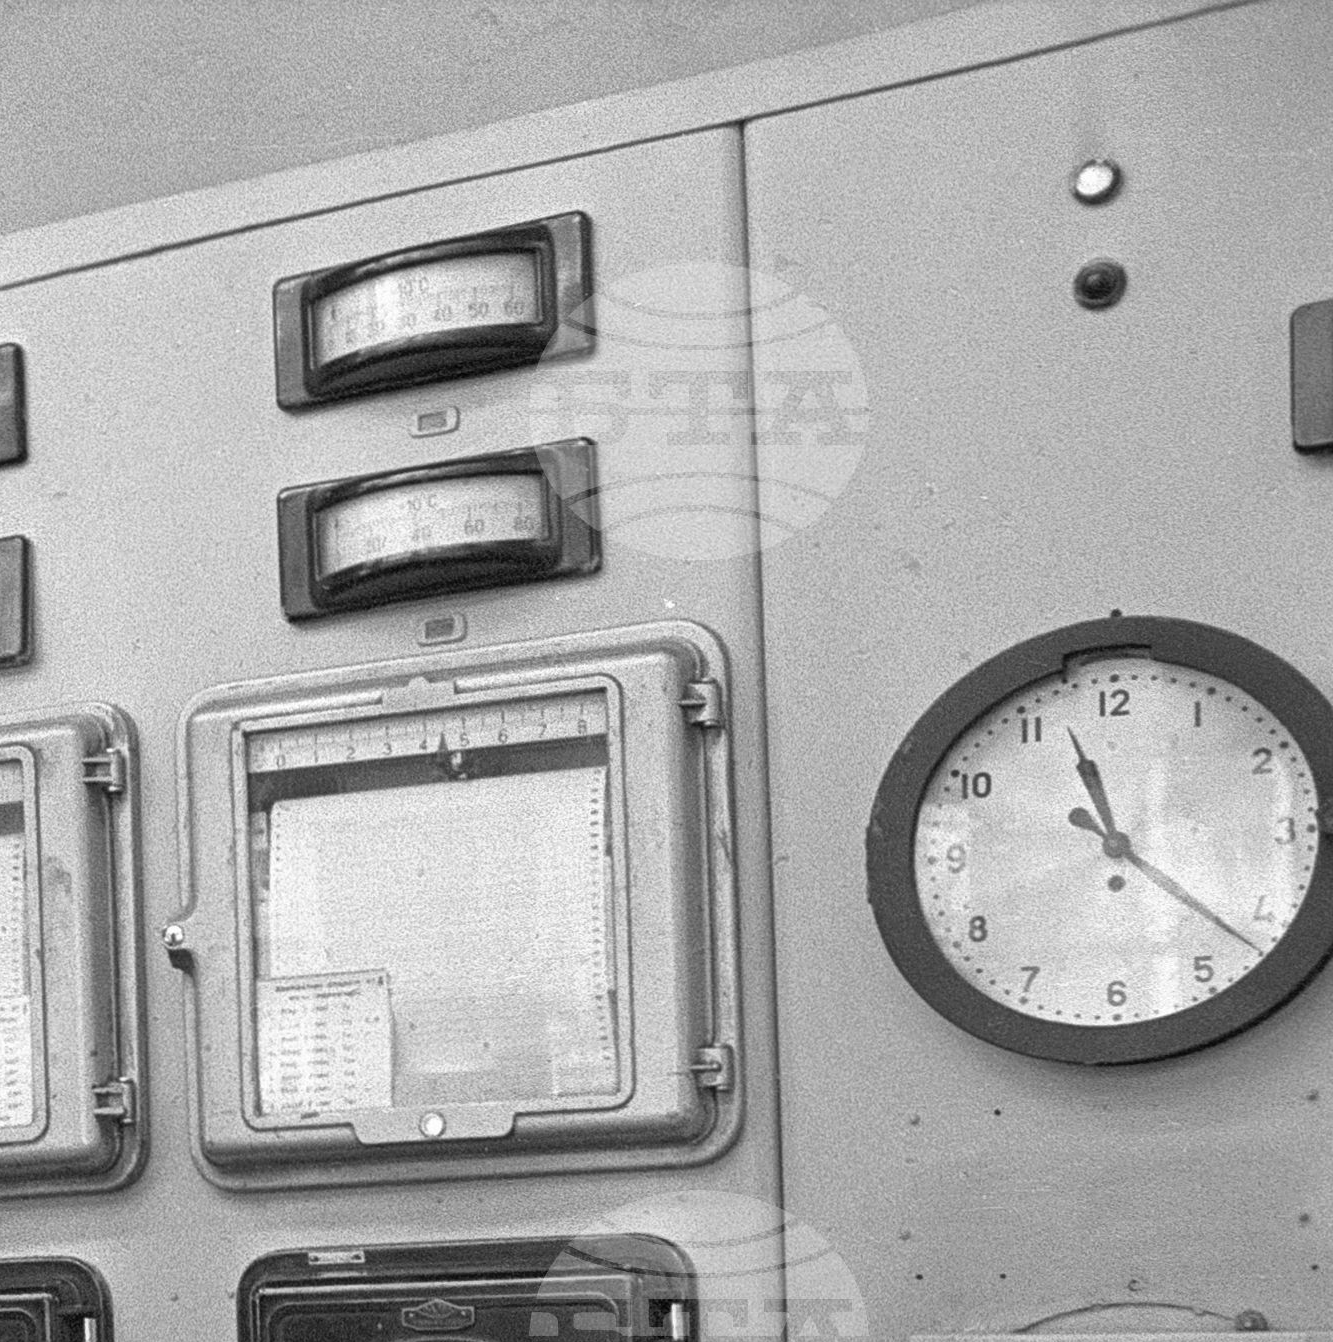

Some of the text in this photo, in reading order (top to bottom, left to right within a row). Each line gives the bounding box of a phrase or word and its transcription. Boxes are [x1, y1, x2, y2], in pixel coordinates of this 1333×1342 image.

[464, 518, 485, 534] 60
[1098, 689, 1131, 717] 12
[1193, 701, 1203, 728] 1
[499, 729, 508, 744] 6
[1020, 716, 1043, 743] 11
[1251, 746, 1274, 776] 2
[960, 770, 993, 800] 10
[945, 843, 968, 873] 9
[967, 914, 990, 943] 8
[1019, 965, 1041, 993] 7
[1192, 955, 1214, 983] 5
[1106, 979, 1128, 1007] 6
